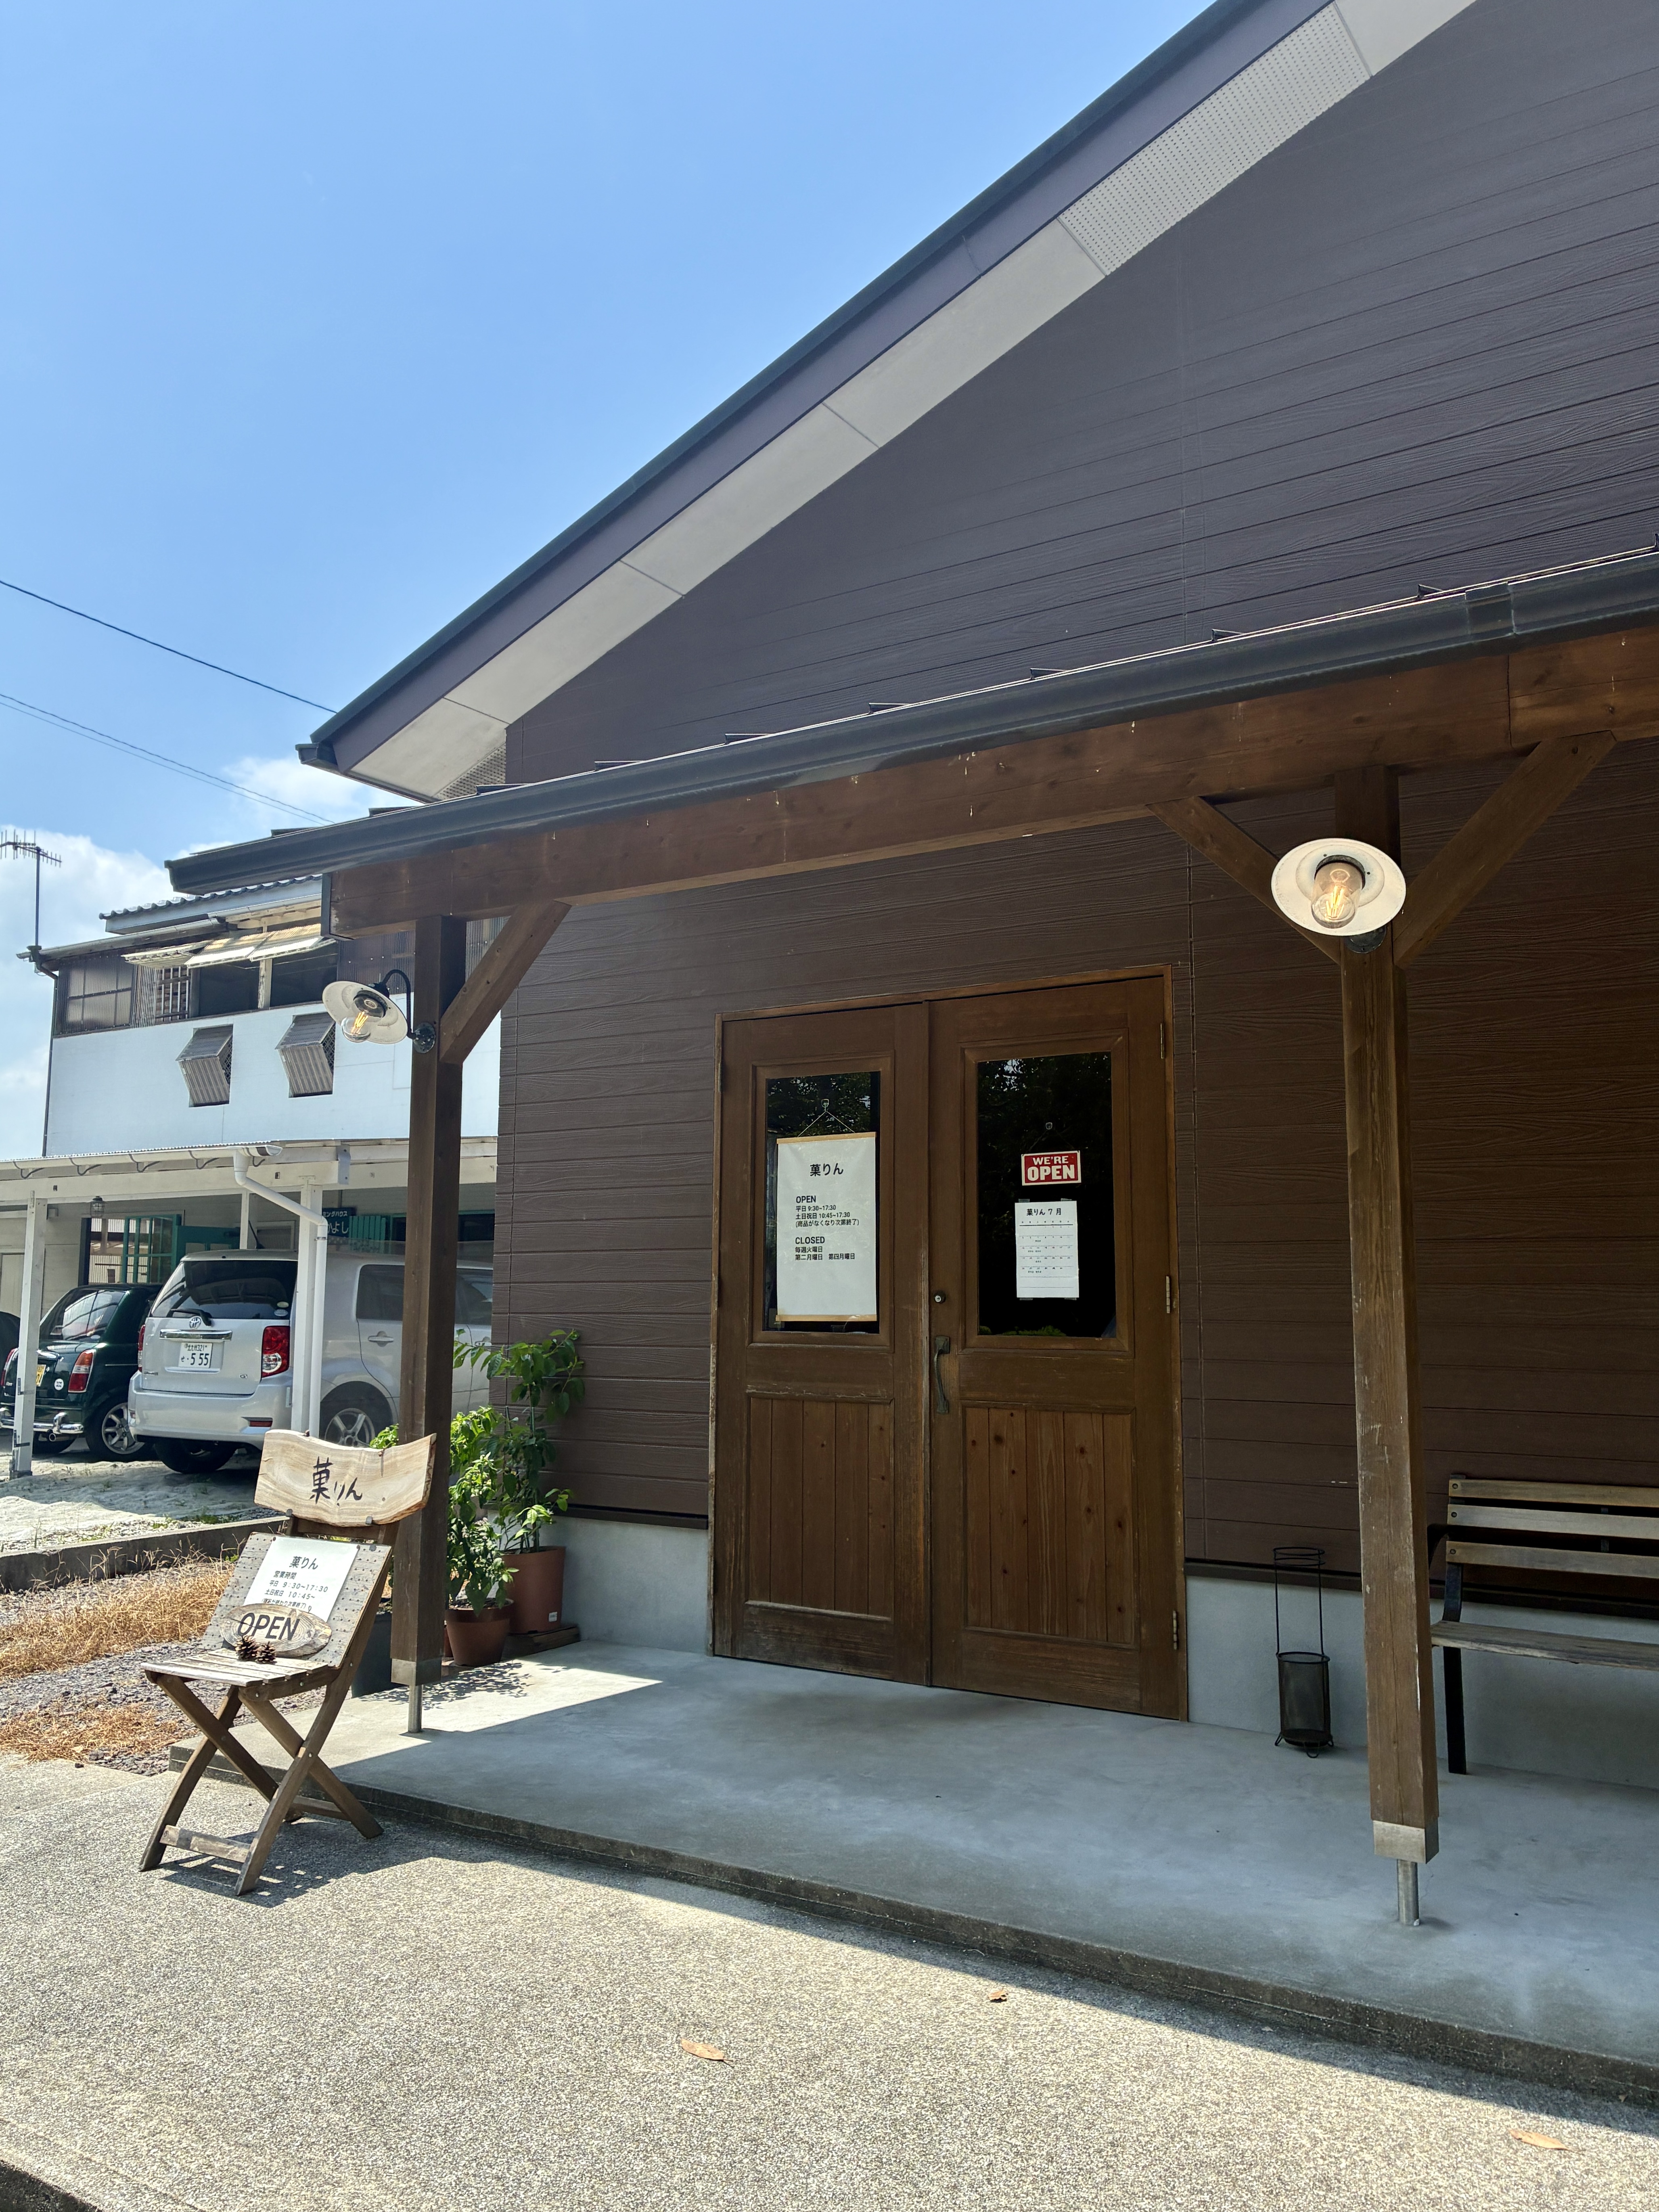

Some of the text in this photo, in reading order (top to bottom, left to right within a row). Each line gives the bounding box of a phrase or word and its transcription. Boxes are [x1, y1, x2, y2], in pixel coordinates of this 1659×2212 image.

[1033, 1156, 1069, 1165] WE'RE
[810, 1163, 843, 1176] 菓りん
[1027, 1164, 1075, 1181] OPEN
[795, 1236, 825, 1244] CLOSED
[309, 1456, 362, 1504] 菓りん
[289, 1556, 318, 1570] 菓りん
[273, 1570, 297, 1580] 営業時間
[238, 1613, 300, 1640] OPEN
